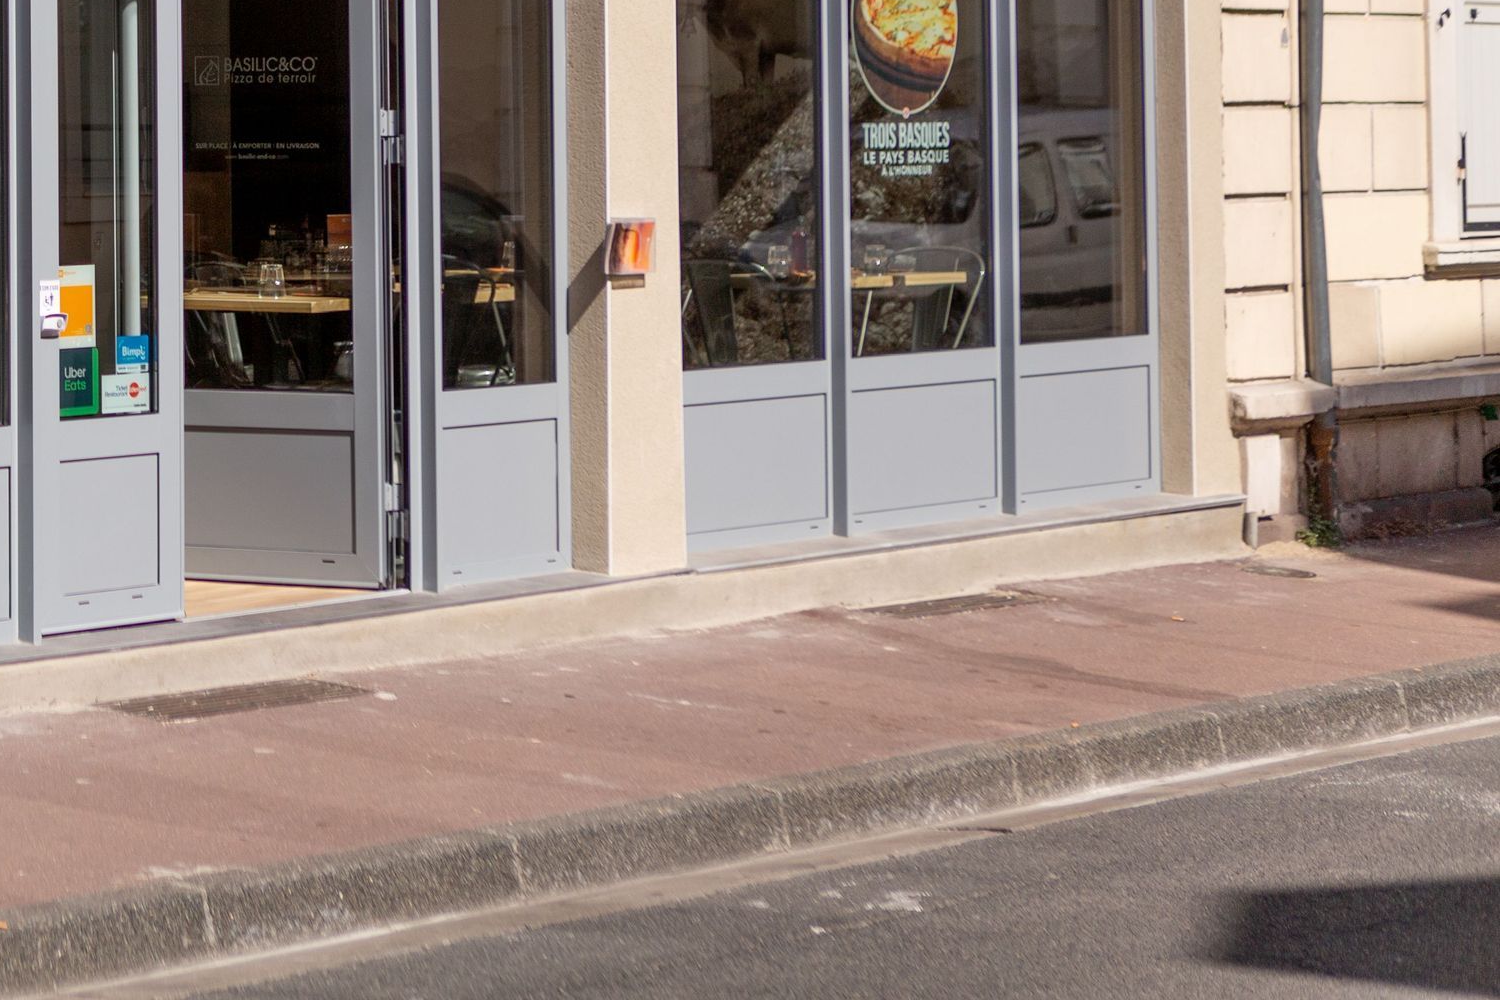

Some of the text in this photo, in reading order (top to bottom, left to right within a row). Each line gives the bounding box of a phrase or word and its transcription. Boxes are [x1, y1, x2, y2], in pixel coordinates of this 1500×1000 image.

[258, 72, 274, 84] de
[862, 120, 950, 150] TROIS BASQUES
[863, 149, 949, 165] LE PAYS BASQUE
[64, 366, 86, 379] Uber
[64, 379, 87, 392] Eats
